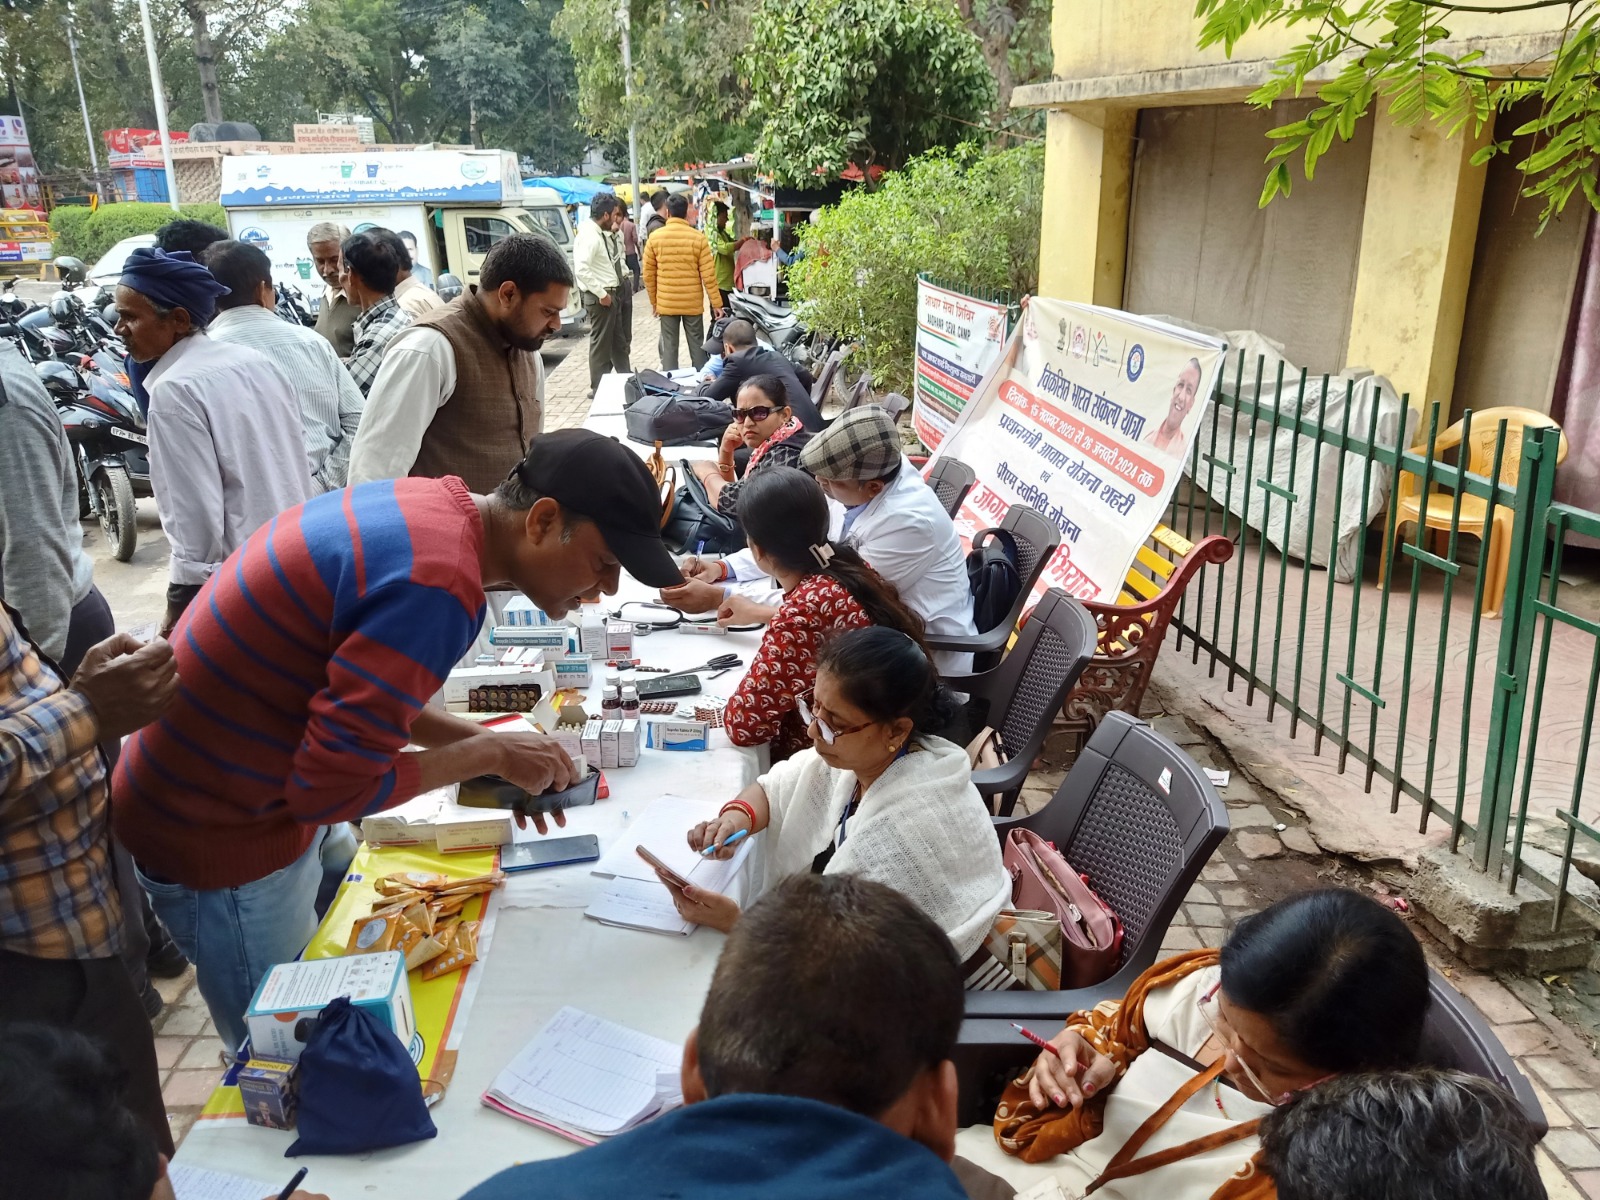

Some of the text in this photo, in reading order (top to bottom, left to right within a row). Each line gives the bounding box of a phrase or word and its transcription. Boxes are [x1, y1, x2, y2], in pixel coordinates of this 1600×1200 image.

[925, 294, 975, 323] आधार सेवा शिविर
[945, 320, 956, 336] SEVA
[957, 325, 971, 342] CAMP
[1037, 362, 1147, 442] विकसित भारत संकल्प यात्रा
[998, 413, 1136, 516] प्रधानमंत्री आवास योजना शहरी
[1030, 403, 1039, 417] 15
[1057, 420, 1076, 439] 2023
[1074, 427, 1085, 445] से
[1081, 434, 1094, 451] 26
[1092, 441, 1119, 466] जनवरी
[1115, 457, 1139, 479] 2024
[1136, 469, 1155, 488] तक
[996, 461, 1019, 490] पीएम
[1016, 480, 1050, 516] स्वनिधि
[1048, 506, 1082, 543] योजना
[1040, 470, 1054, 483] एवं
[252, 1061, 279, 1069] Control
